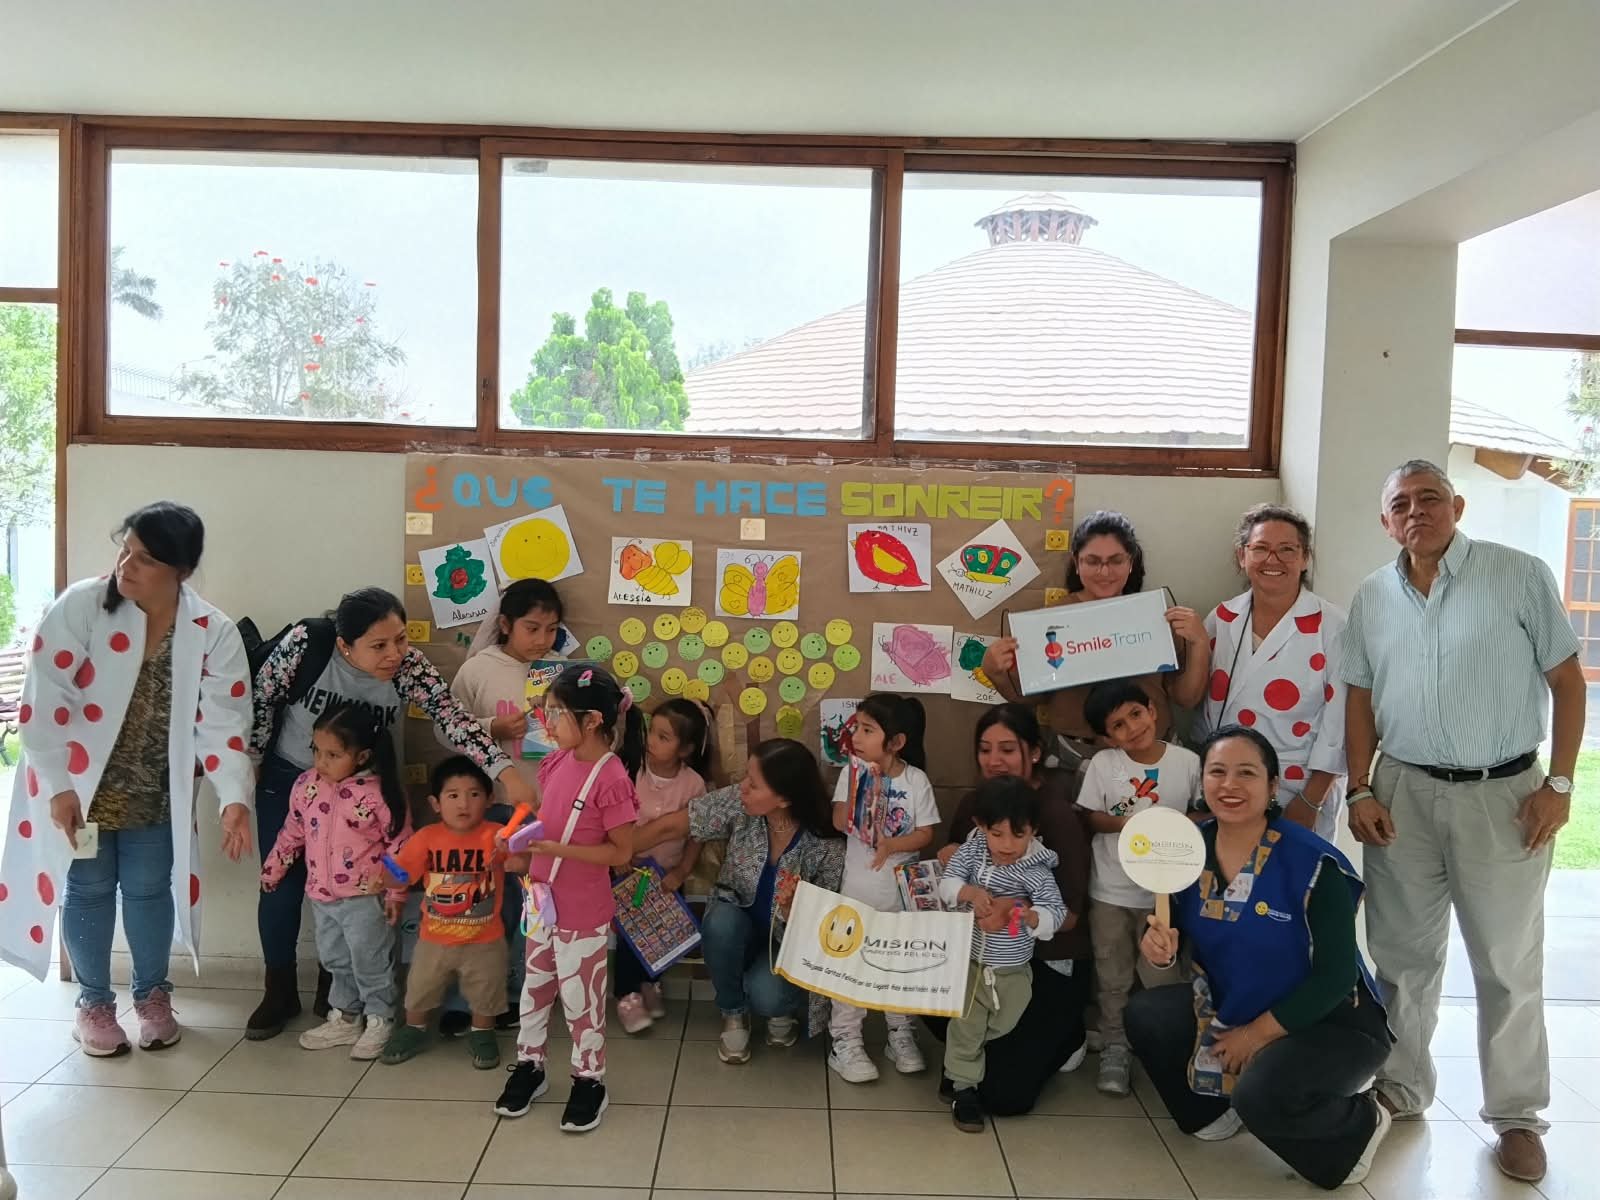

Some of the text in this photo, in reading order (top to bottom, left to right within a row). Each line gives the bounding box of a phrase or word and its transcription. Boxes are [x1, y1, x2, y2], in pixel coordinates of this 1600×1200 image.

[603, 477, 667, 514] TE
[694, 480, 827, 517] HACE
[864, 936, 947, 952] MISION
